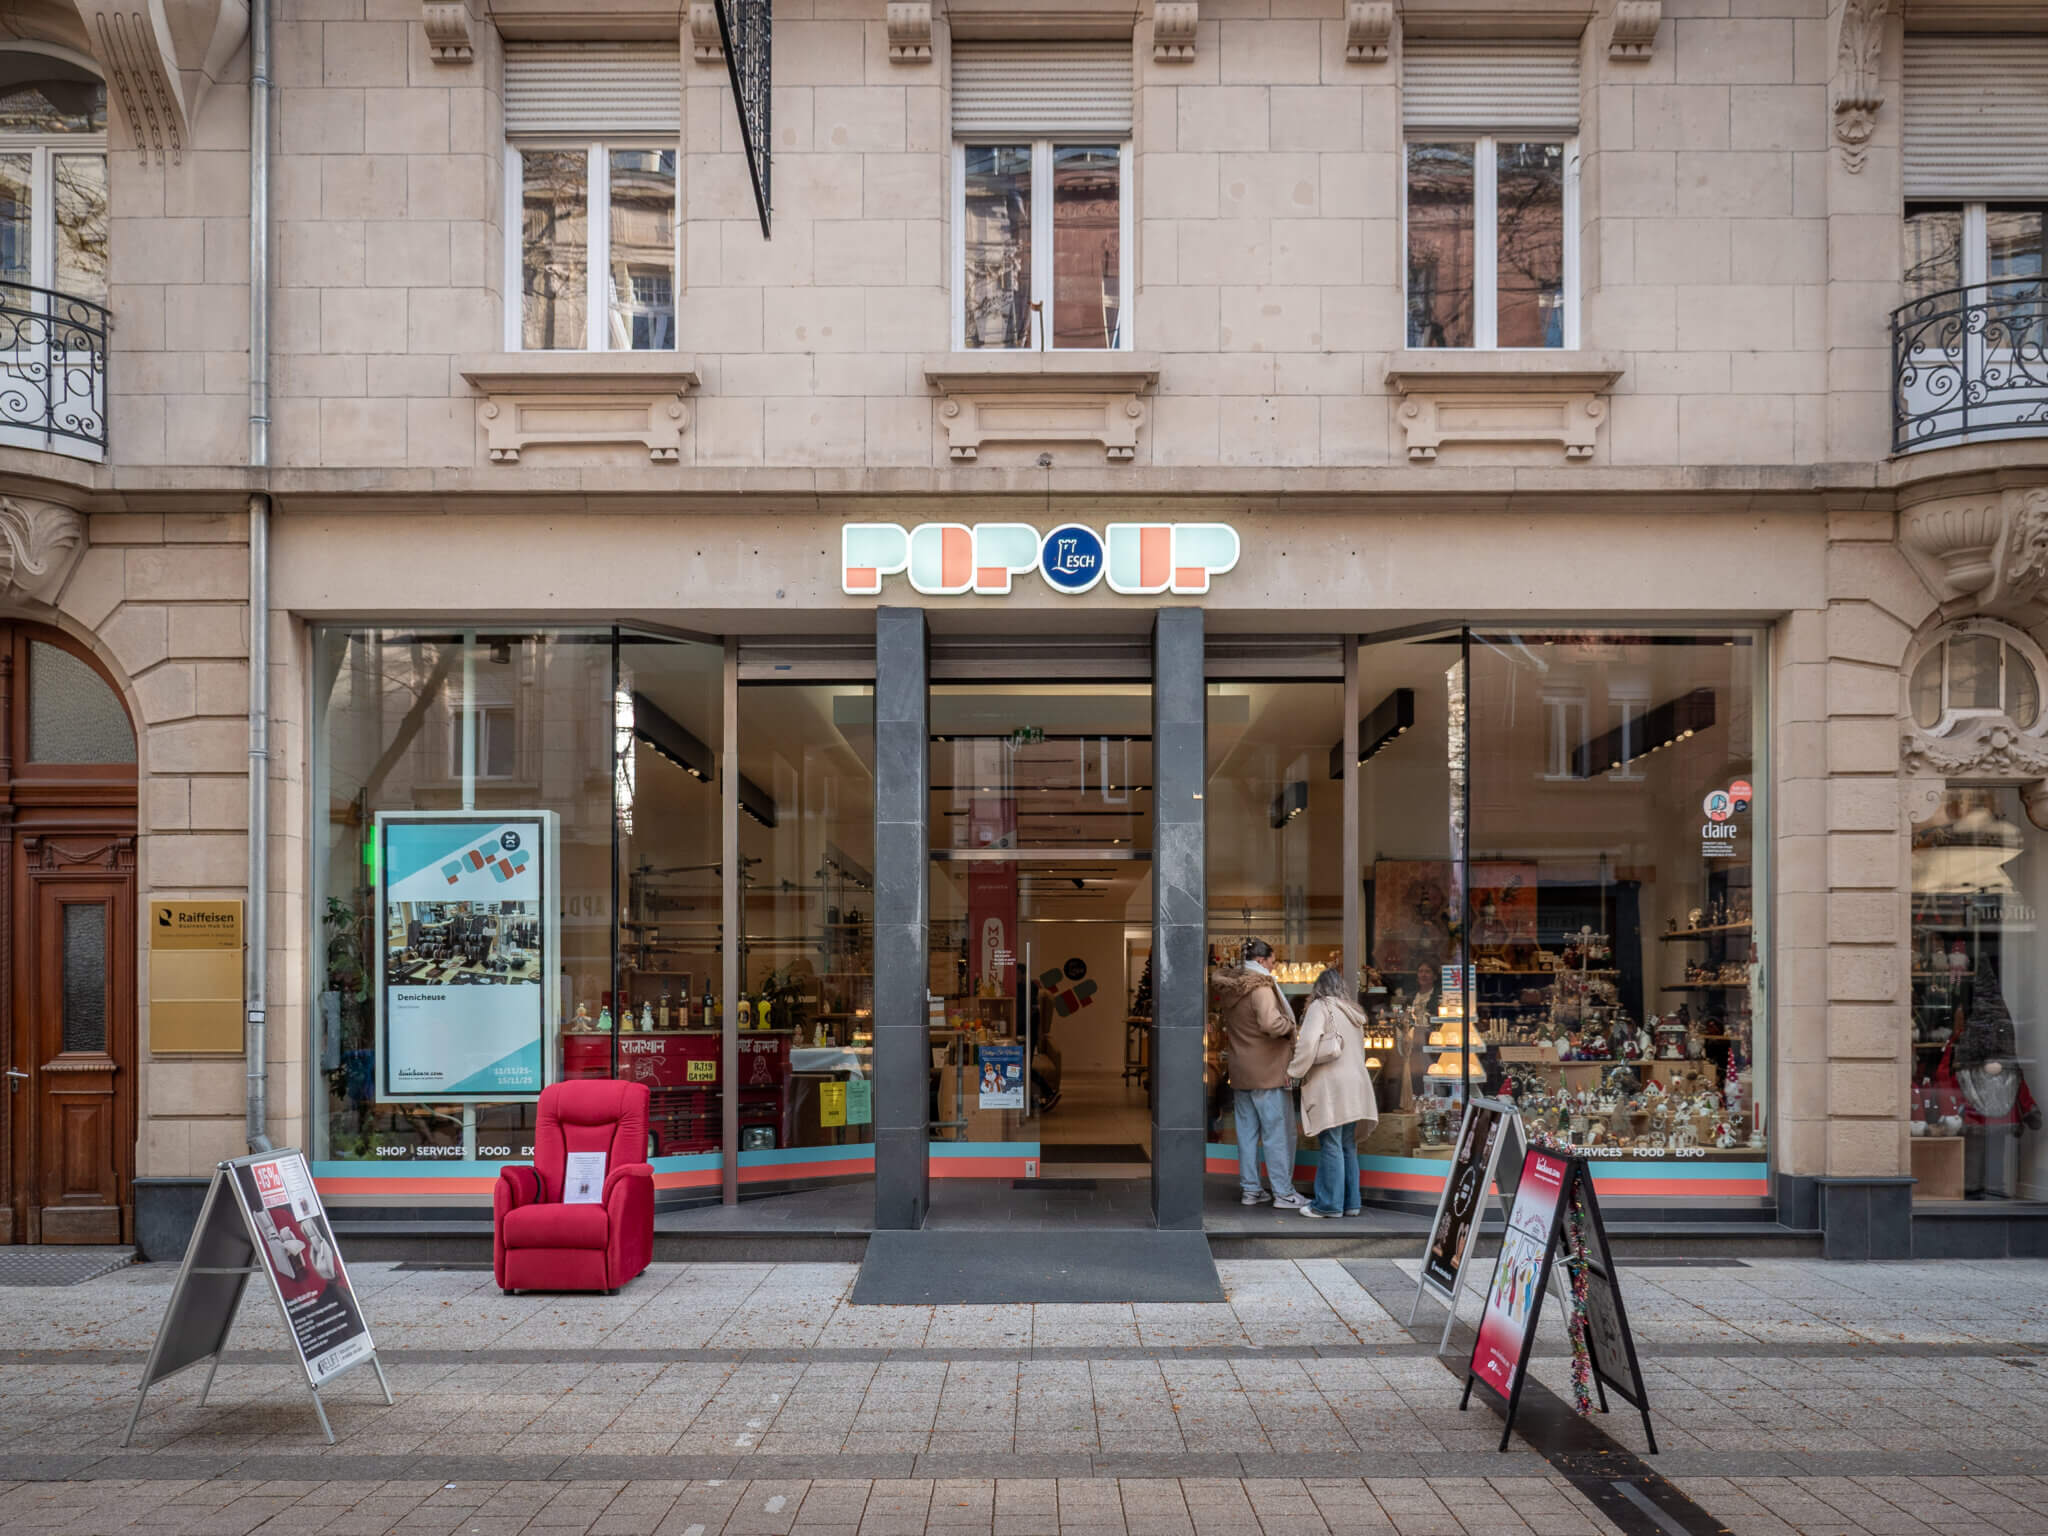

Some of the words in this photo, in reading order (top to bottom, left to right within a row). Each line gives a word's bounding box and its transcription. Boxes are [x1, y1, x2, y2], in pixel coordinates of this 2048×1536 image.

[1702, 821, 1737, 838] claire
[179, 912, 234, 922] Raiffeisen
[397, 993, 446, 1001] Denicheuse
[376, 1146, 407, 1156] SHOP
[416, 1146, 468, 1156] SERVICES
[479, 1146, 511, 1156] FOOD
[521, 1146, 534, 1156] EX
[1633, 1147, 1665, 1158] FOOD
[1675, 1147, 1705, 1158] EXPO
